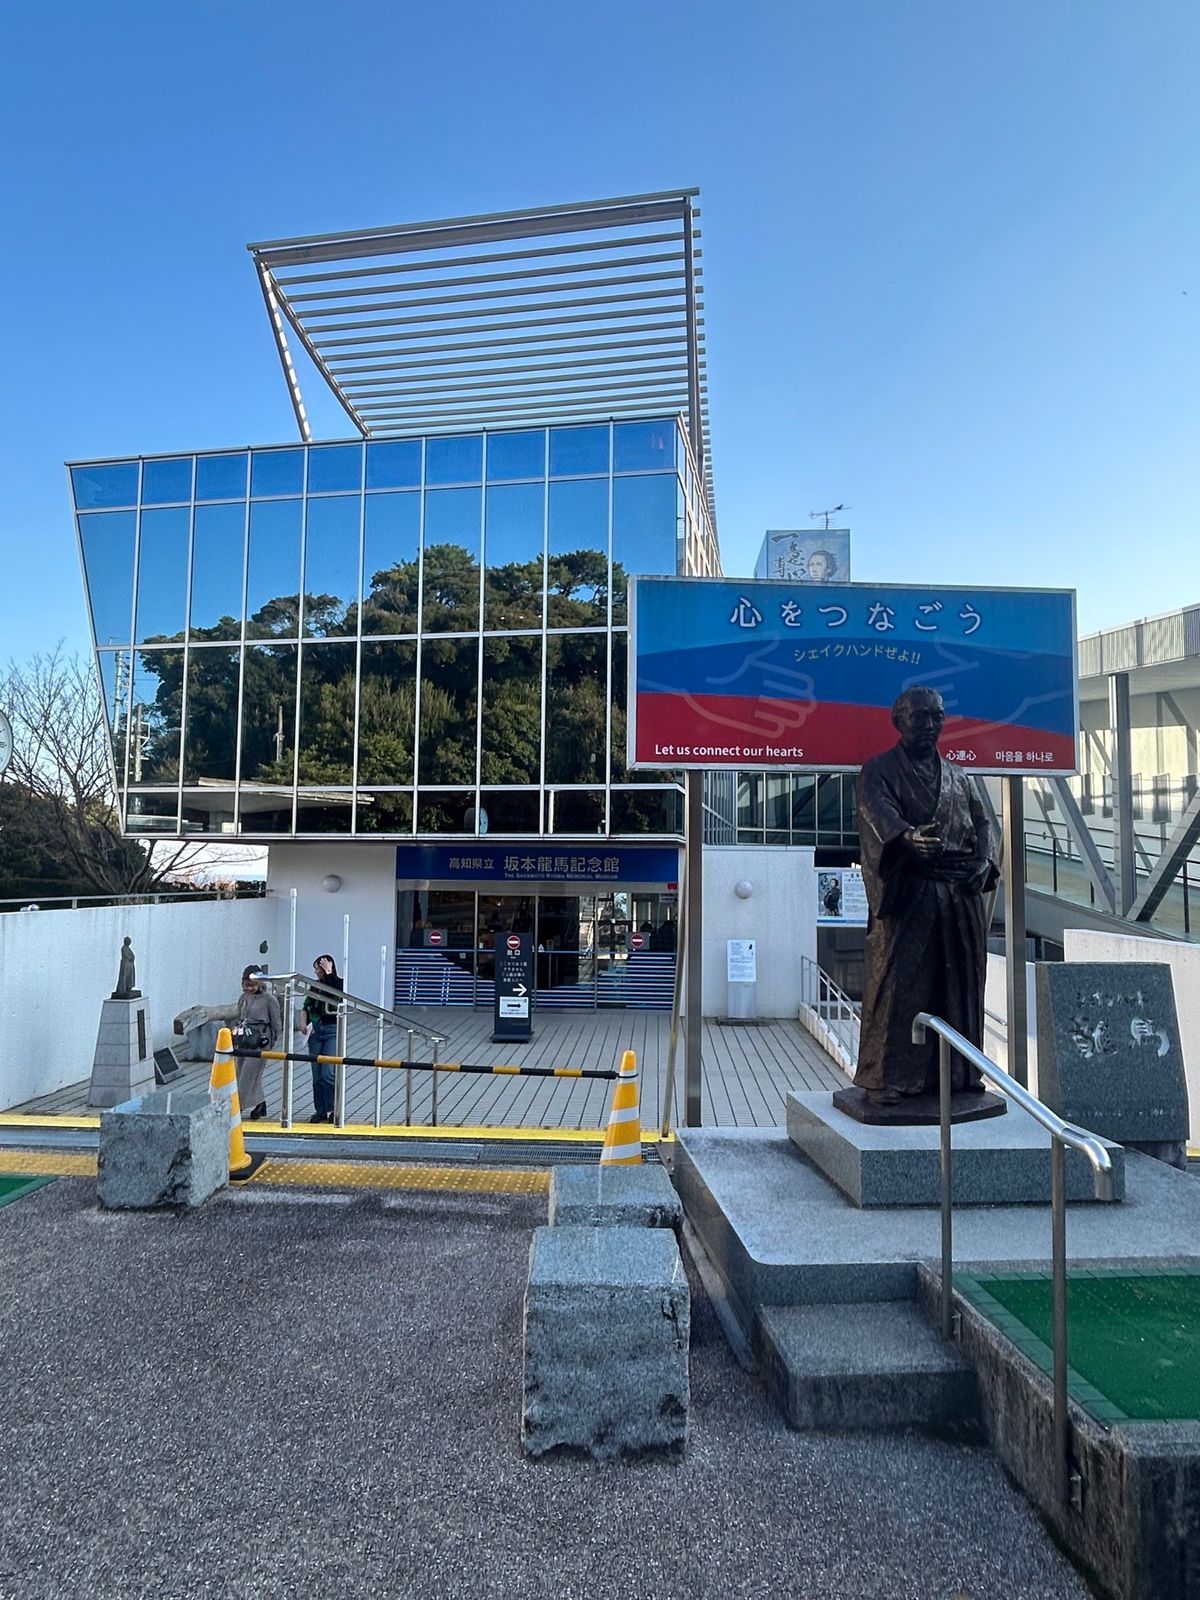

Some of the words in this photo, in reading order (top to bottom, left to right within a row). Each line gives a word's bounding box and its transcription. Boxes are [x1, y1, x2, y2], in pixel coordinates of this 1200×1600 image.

[730, 597, 981, 635] 心をつなごう
[655, 744, 670, 755] Let
[676, 747, 690, 756] us
[693, 745, 741, 756] connect
[743, 747, 763, 757] our
[766, 745, 803, 757] hearts
[946, 750, 977, 761] 心連心
[995, 751, 1023, 762] 마음을
[1026, 751, 1054, 762] 하나로
[449, 857, 494, 869] 高知県立
[504, 855, 620, 872] 坂本龍馬記念館
